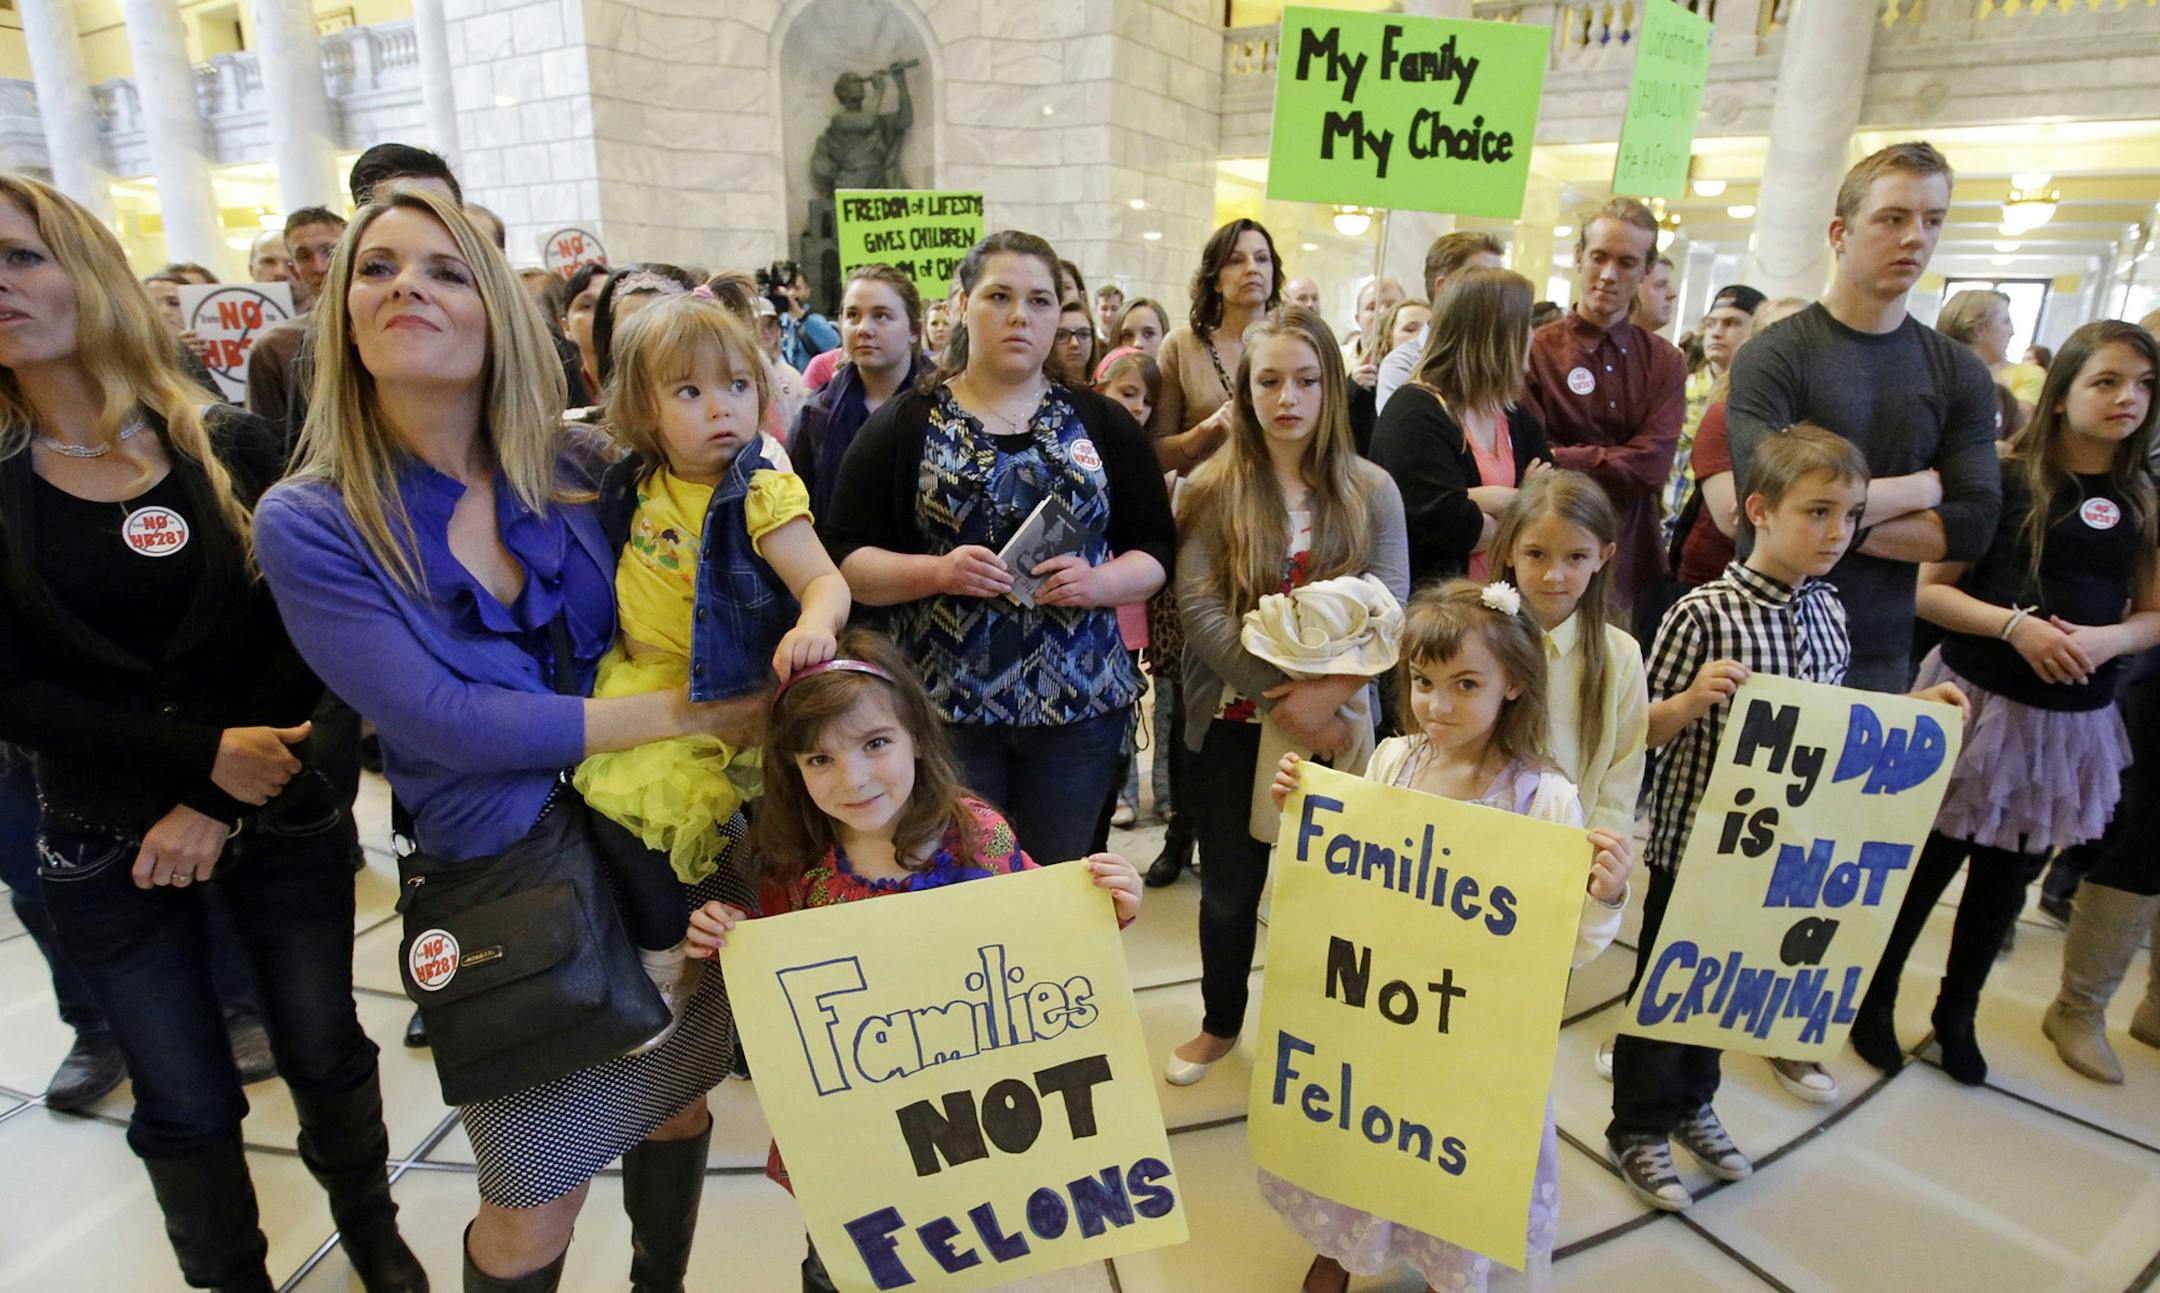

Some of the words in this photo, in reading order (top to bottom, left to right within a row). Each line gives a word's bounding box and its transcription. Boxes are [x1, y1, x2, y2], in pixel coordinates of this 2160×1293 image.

[1295, 27, 1368, 103] My
[1380, 24, 1480, 105] Family
[1320, 111, 1395, 178] My
[1408, 108, 1514, 164] Choice
[843, 197, 909, 222] FREEDOM
[911, 197, 924, 215] of
[864, 231, 905, 253] GIVES
[910, 227, 975, 251] CHILDREN
[558, 236, 585, 258] NO
[919, 259, 933, 277] of
[217, 300, 263, 331] NO
[129, 530, 185, 549] HB281
[142, 514, 169, 531] NO
[1733, 698, 1827, 807] My
[1831, 702, 1947, 795] DAD
[1717, 787, 1779, 858] is
[1296, 793, 1518, 936] Families
[415, 954, 457, 984] HB281
[423, 939, 443, 959] NO
[1780, 916, 1840, 966] a
[1325, 935, 1466, 1034] Not
[1636, 940, 1864, 1045] CRIMINAL
[776, 944, 1099, 1096] Families
[895, 1054, 1114, 1177] NOT
[1271, 1029, 1468, 1177] Felons
[844, 1157, 1175, 1291] FELONS
